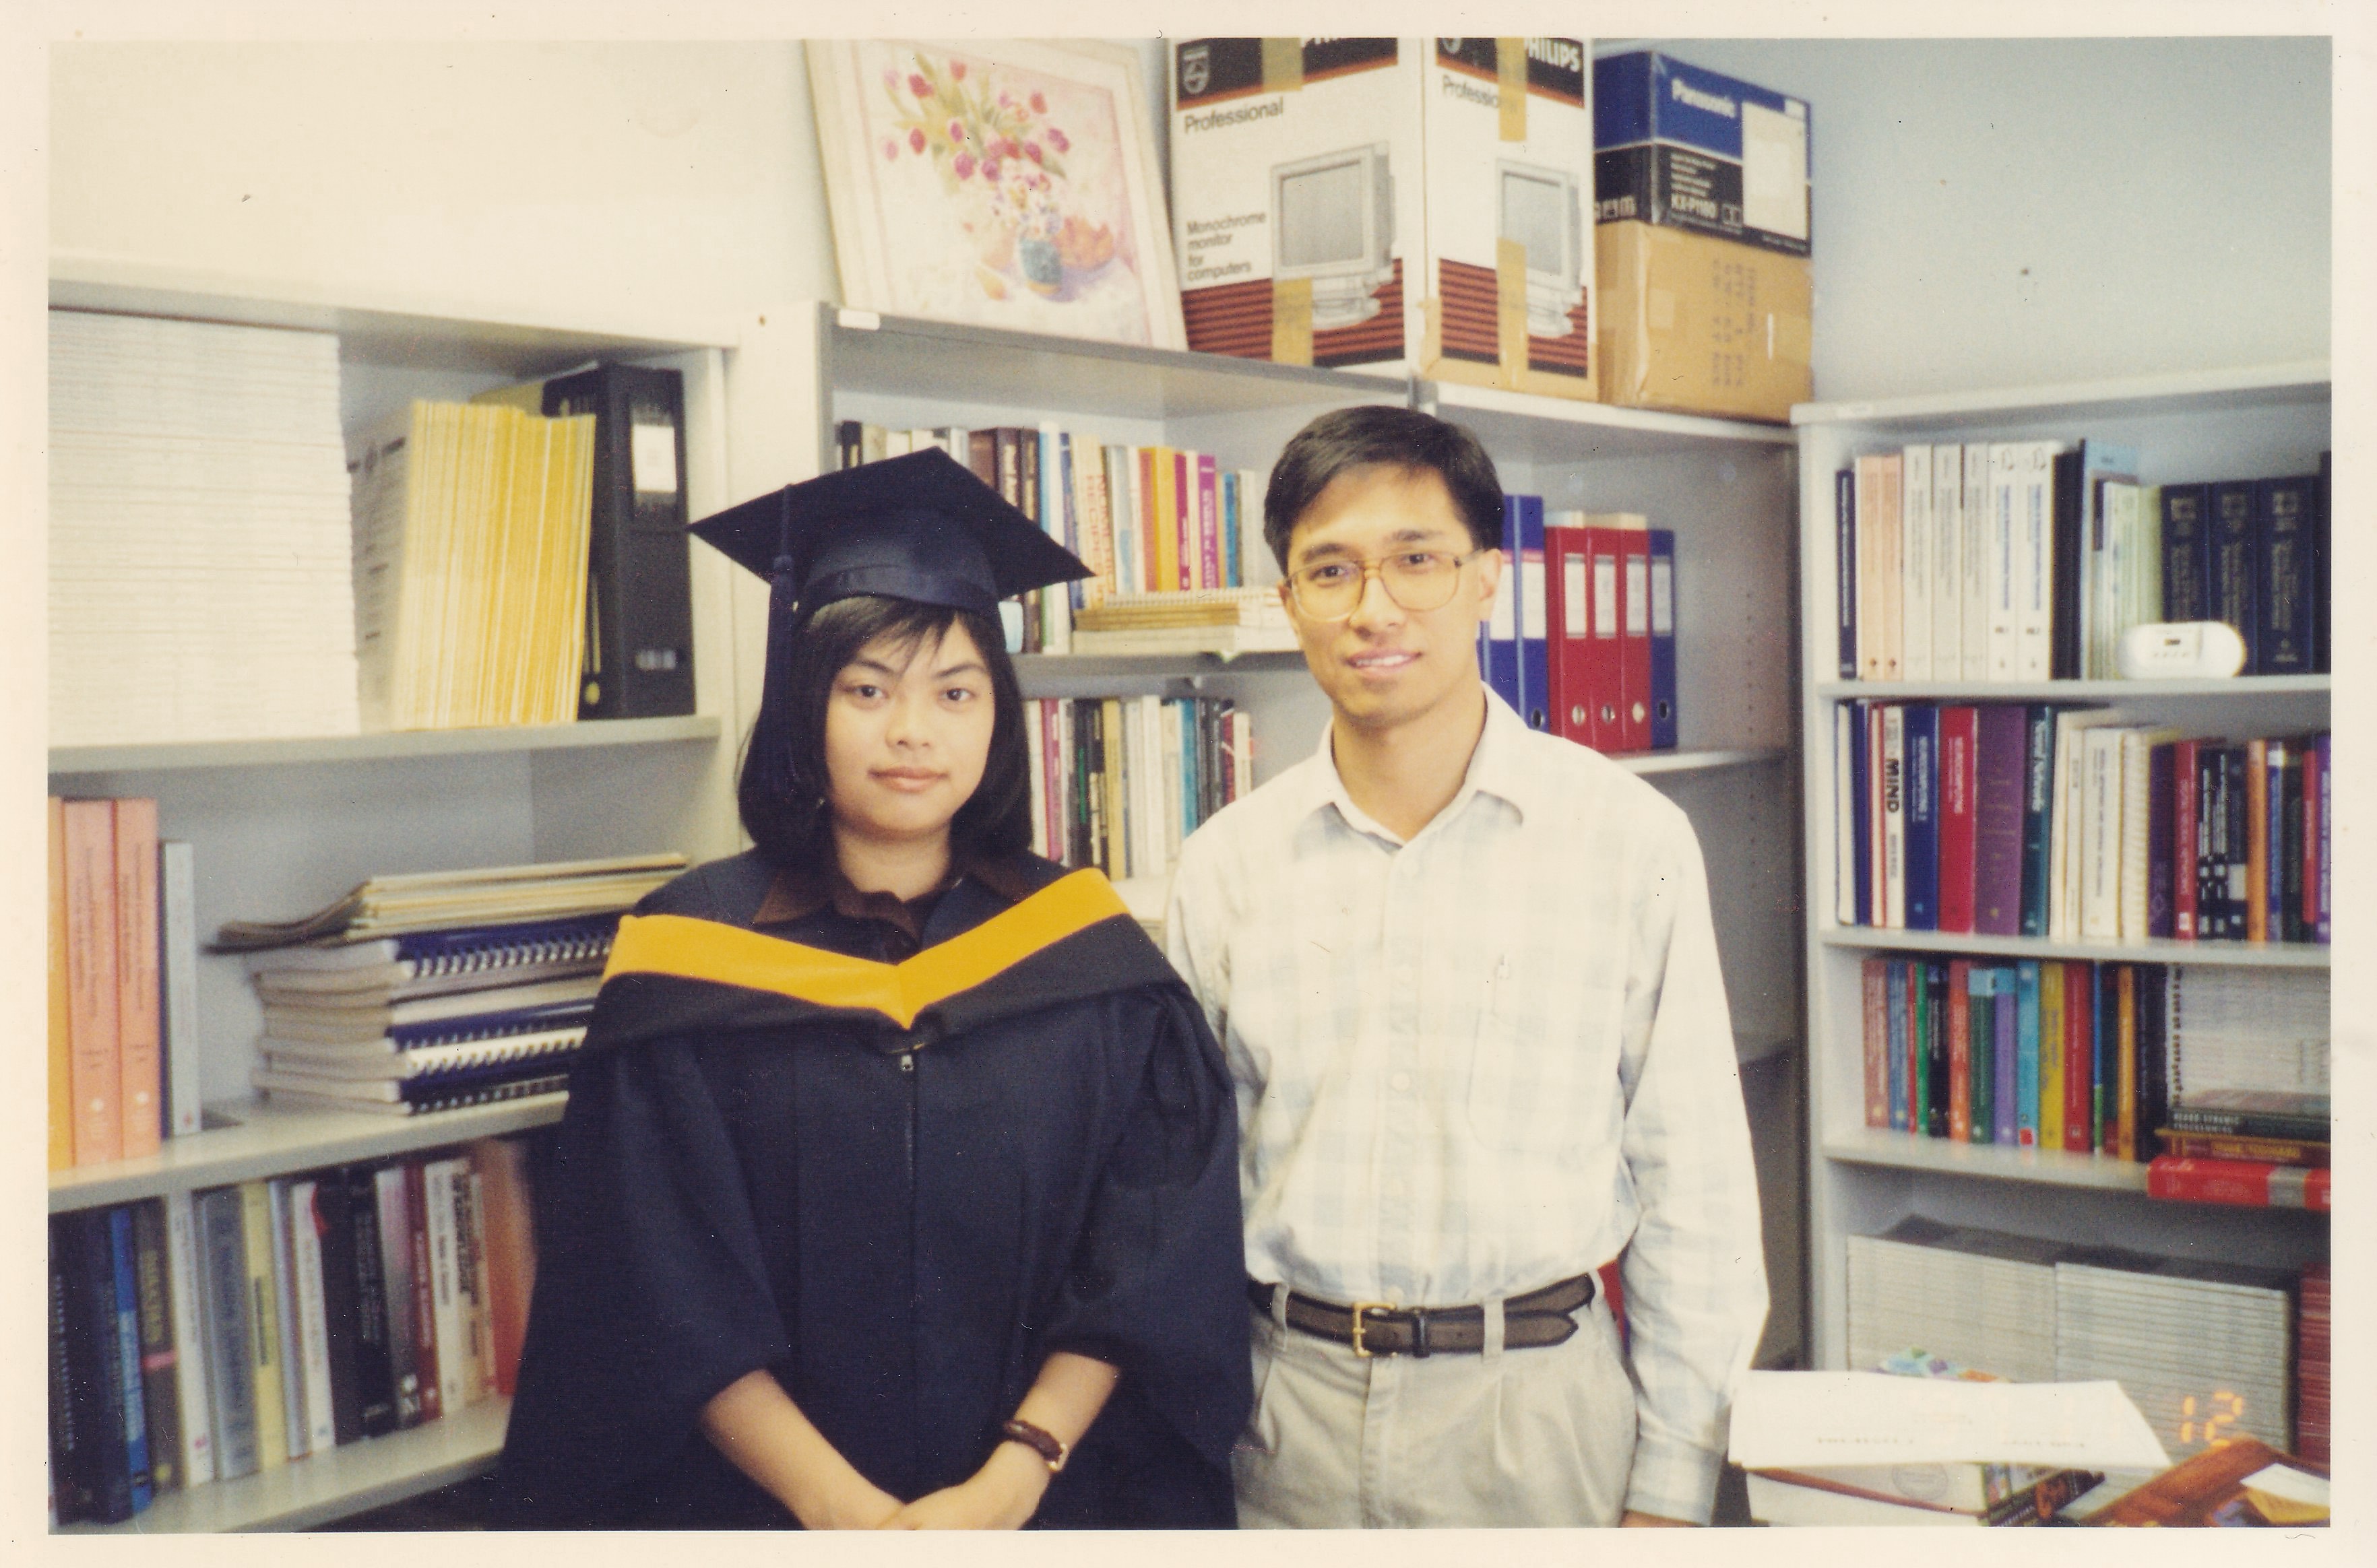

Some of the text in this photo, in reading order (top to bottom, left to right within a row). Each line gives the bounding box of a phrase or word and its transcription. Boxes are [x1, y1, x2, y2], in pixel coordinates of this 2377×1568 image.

[1443, 75, 1517, 114] Professio
[1184, 96, 1284, 133] Professional
[1187, 213, 1265, 236] Monochrome
[1187, 234, 1232, 250] monitor
[1187, 262, 1251, 282] computers
[1886, 758, 1900, 813] MIND
